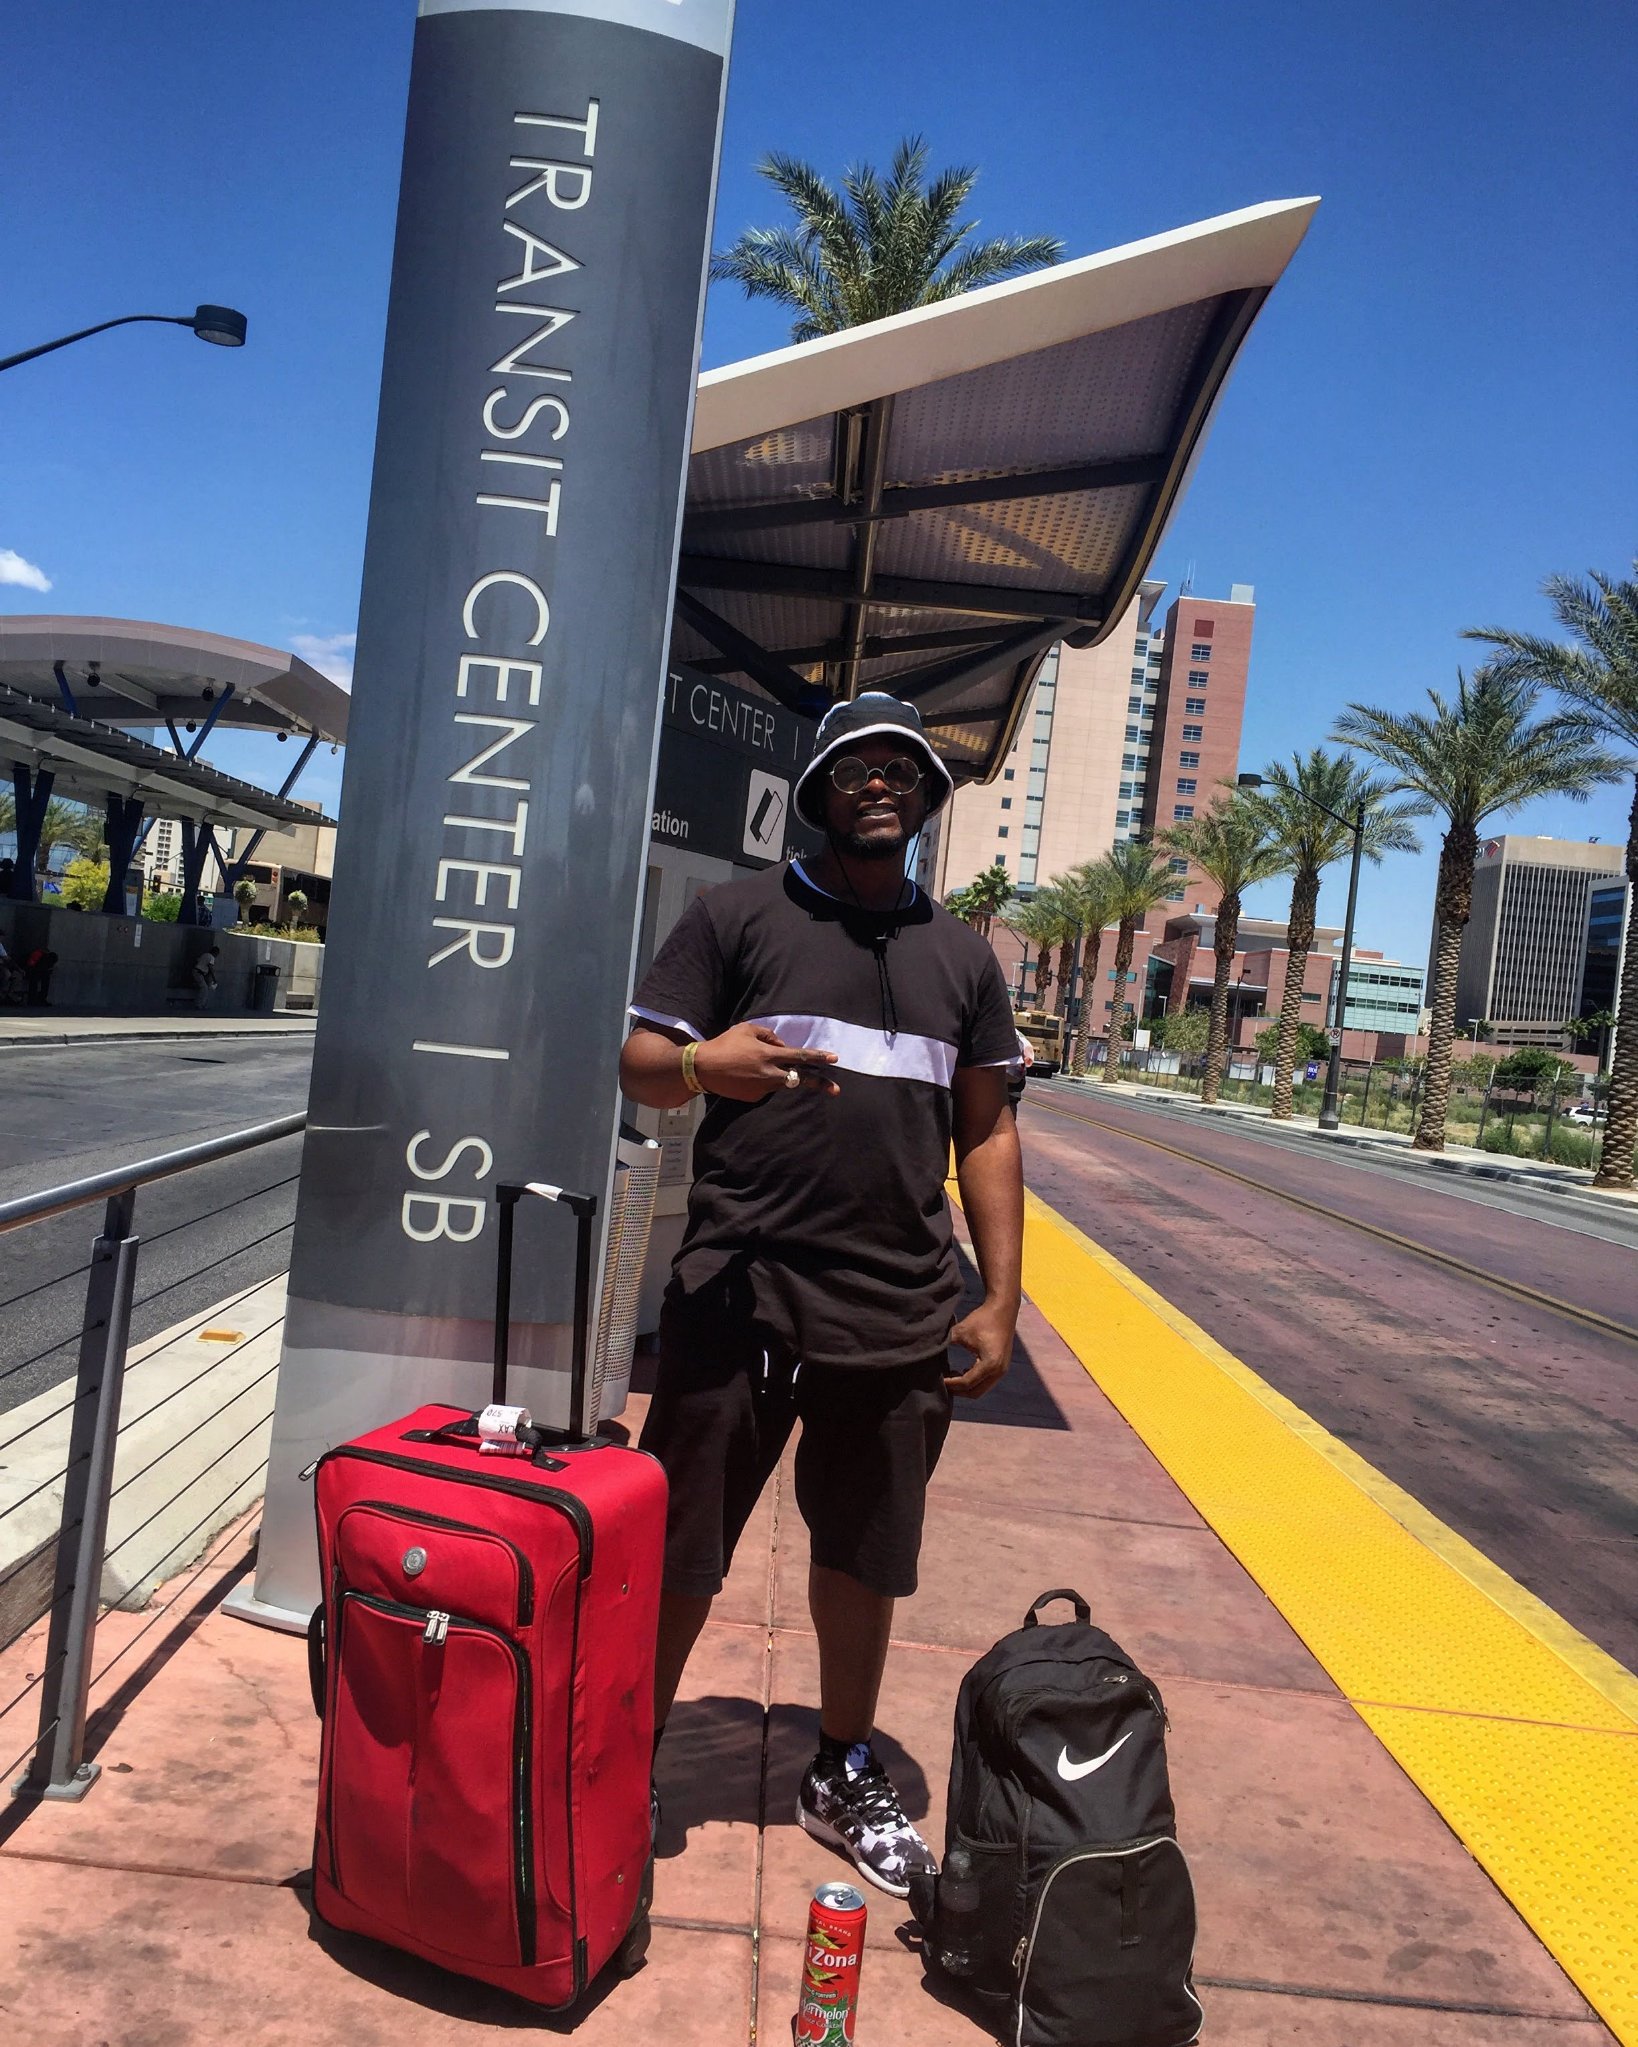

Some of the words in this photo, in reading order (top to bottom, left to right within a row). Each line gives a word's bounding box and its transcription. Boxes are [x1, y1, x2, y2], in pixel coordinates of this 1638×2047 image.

[476, 97, 599, 538] TRANSIT
[428, 569, 550, 969] CENTER
[690, 684, 775, 752] CENTER
[401, 1128, 493, 1243] SB
